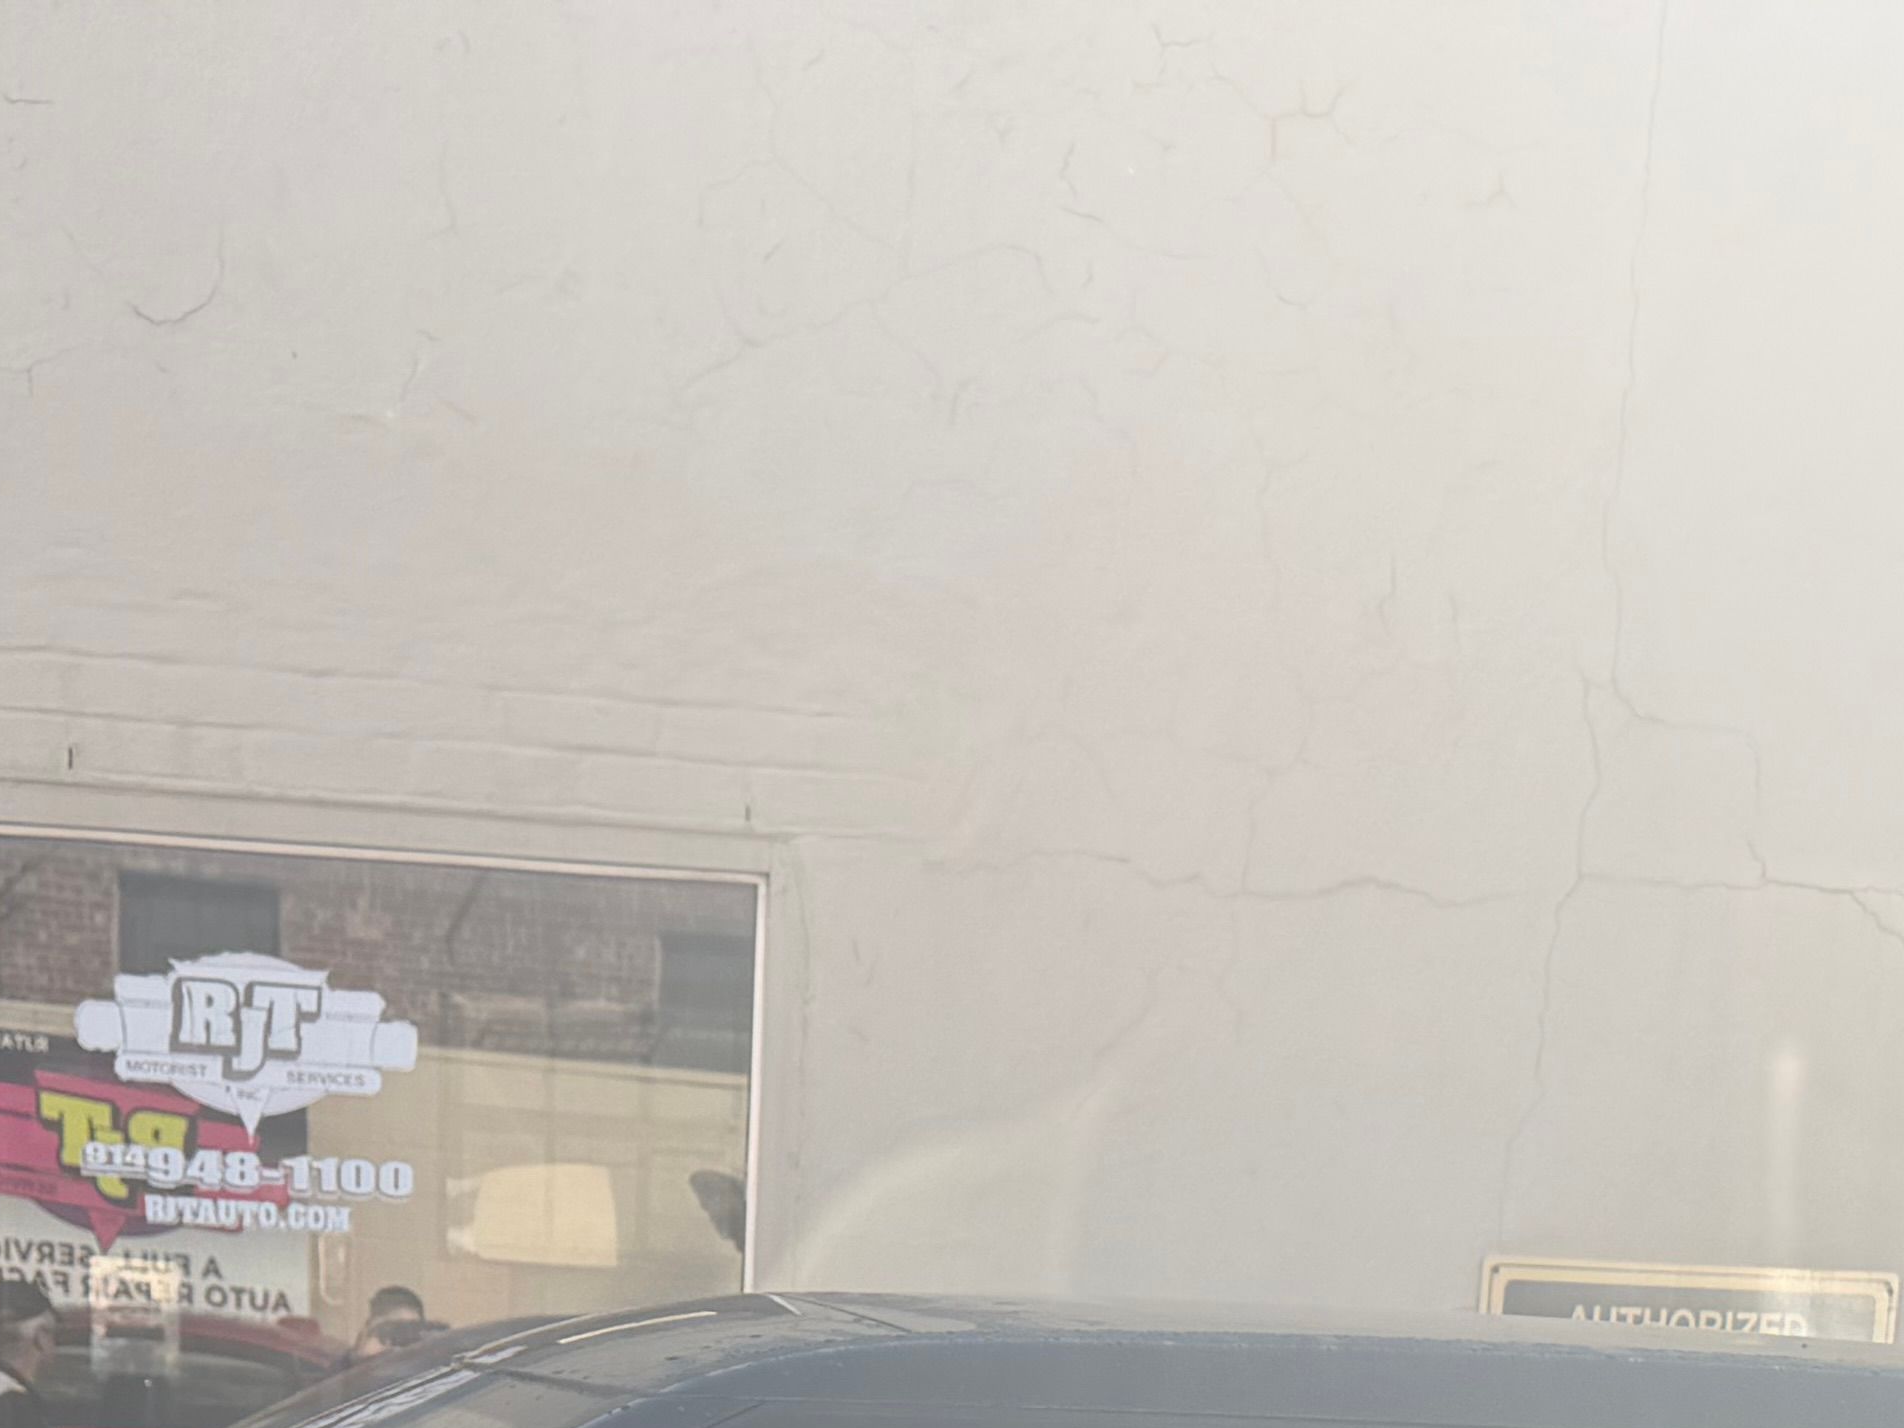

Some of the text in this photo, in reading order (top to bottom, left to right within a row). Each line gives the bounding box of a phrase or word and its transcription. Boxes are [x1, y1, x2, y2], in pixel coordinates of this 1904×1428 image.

[125, 1058, 367, 1089] MOTORIST SERVICES
[146, 1146, 414, 1199] 948-1100
